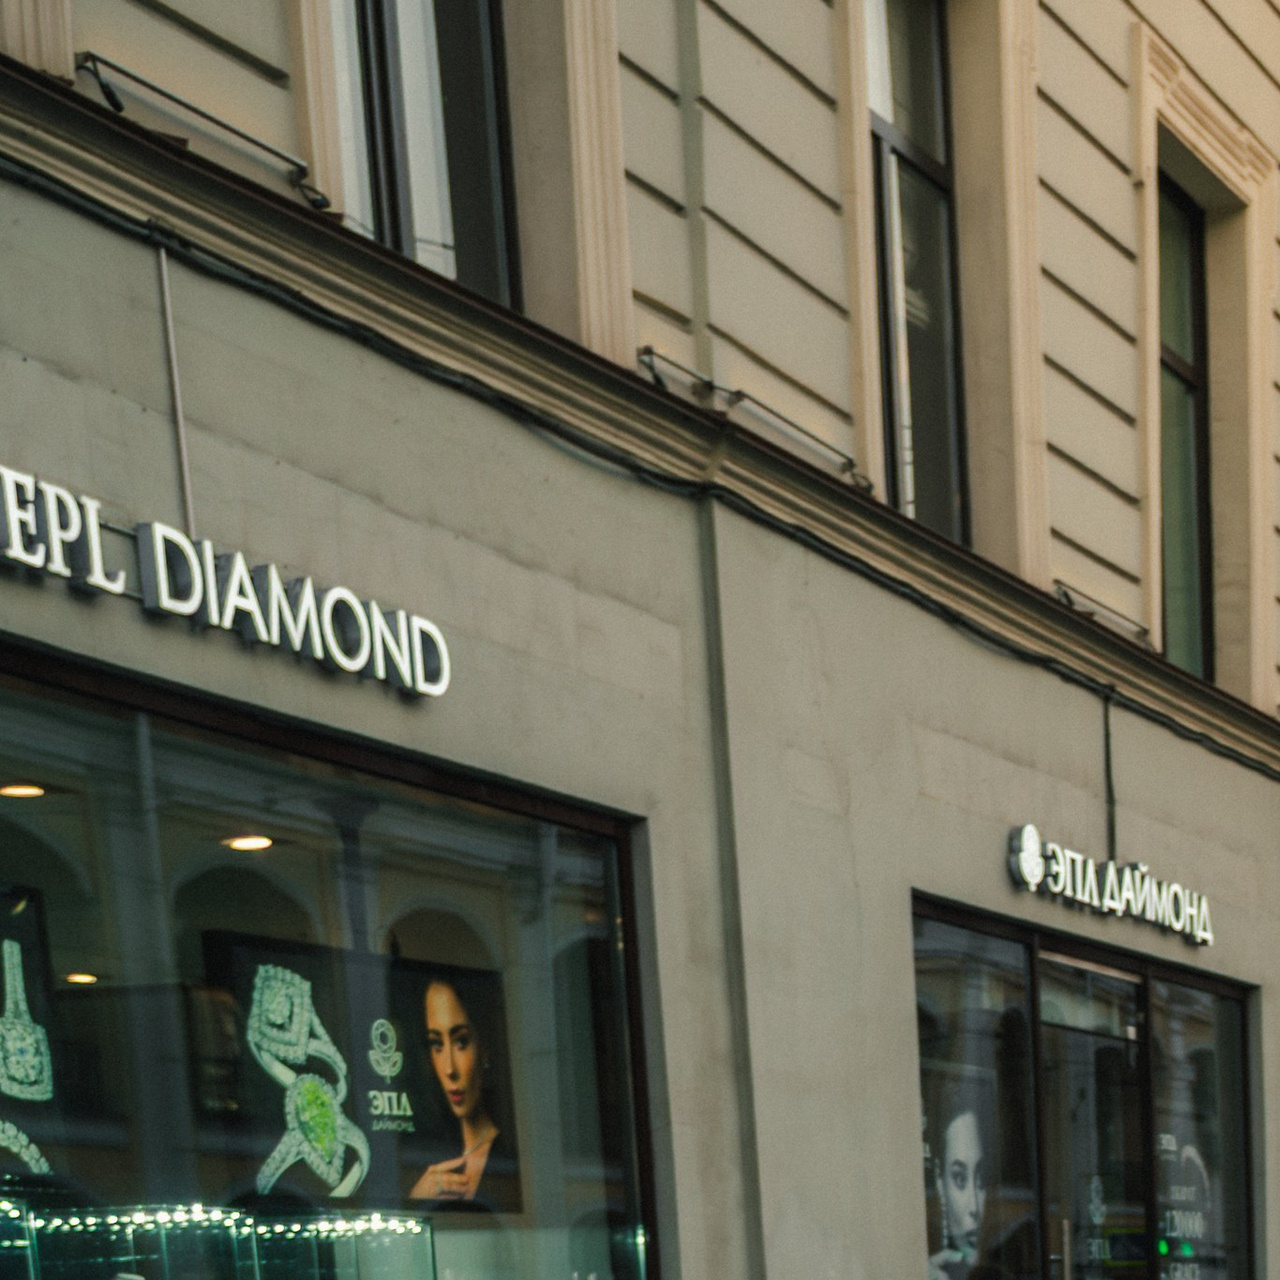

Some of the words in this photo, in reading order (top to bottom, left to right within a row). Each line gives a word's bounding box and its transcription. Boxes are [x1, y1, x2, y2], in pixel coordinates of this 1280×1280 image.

[0, 465, 126, 594] EPL
[153, 520, 450, 697] DIAMOND
[1046, 843, 1100, 907] ЭПЛ
[1102, 860, 1213, 946] ДАЙМОНД
[368, 1090, 413, 1116] ЭПЛ
